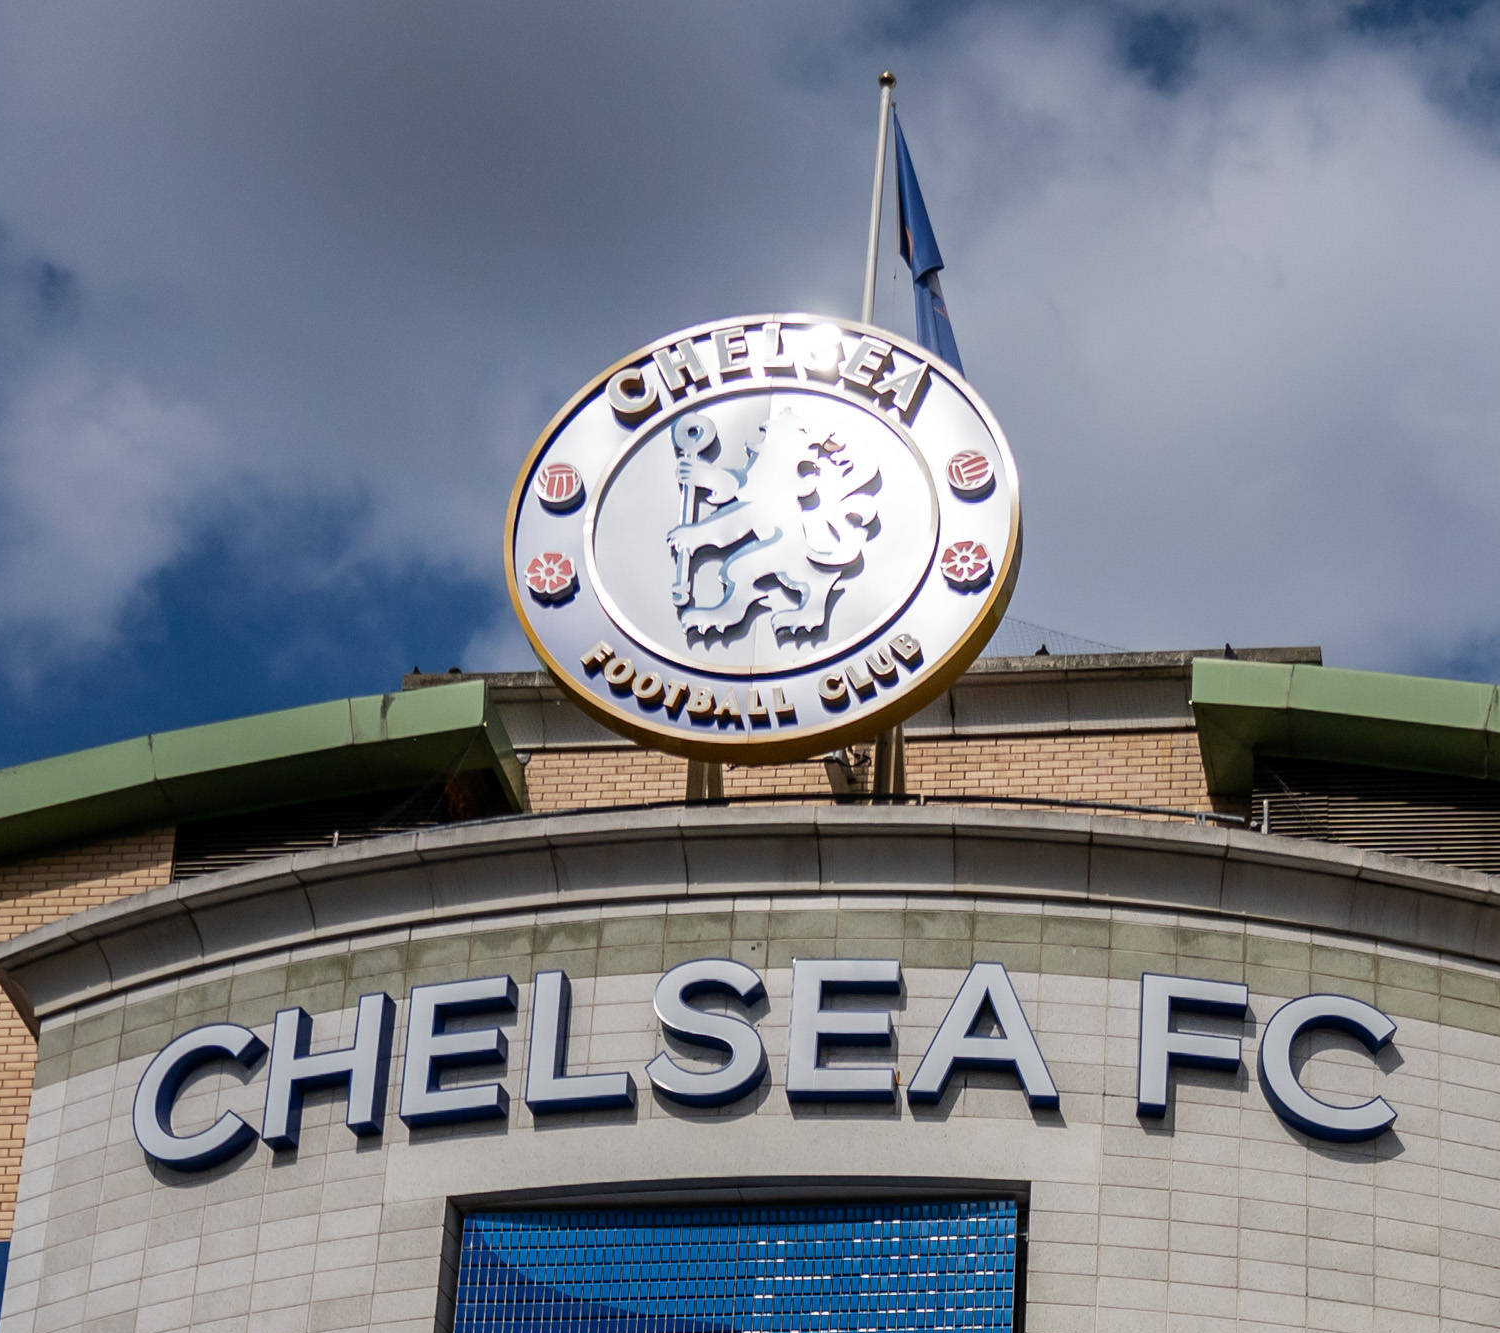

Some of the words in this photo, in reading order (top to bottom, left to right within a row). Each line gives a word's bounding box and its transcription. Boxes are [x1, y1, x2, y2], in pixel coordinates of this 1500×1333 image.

[580, 640, 795, 716] FOOTBALL
[818, 633, 921, 701] CLUB
[132, 957, 1060, 1171] CHELSEA
[1136, 970, 1400, 1143] FC
